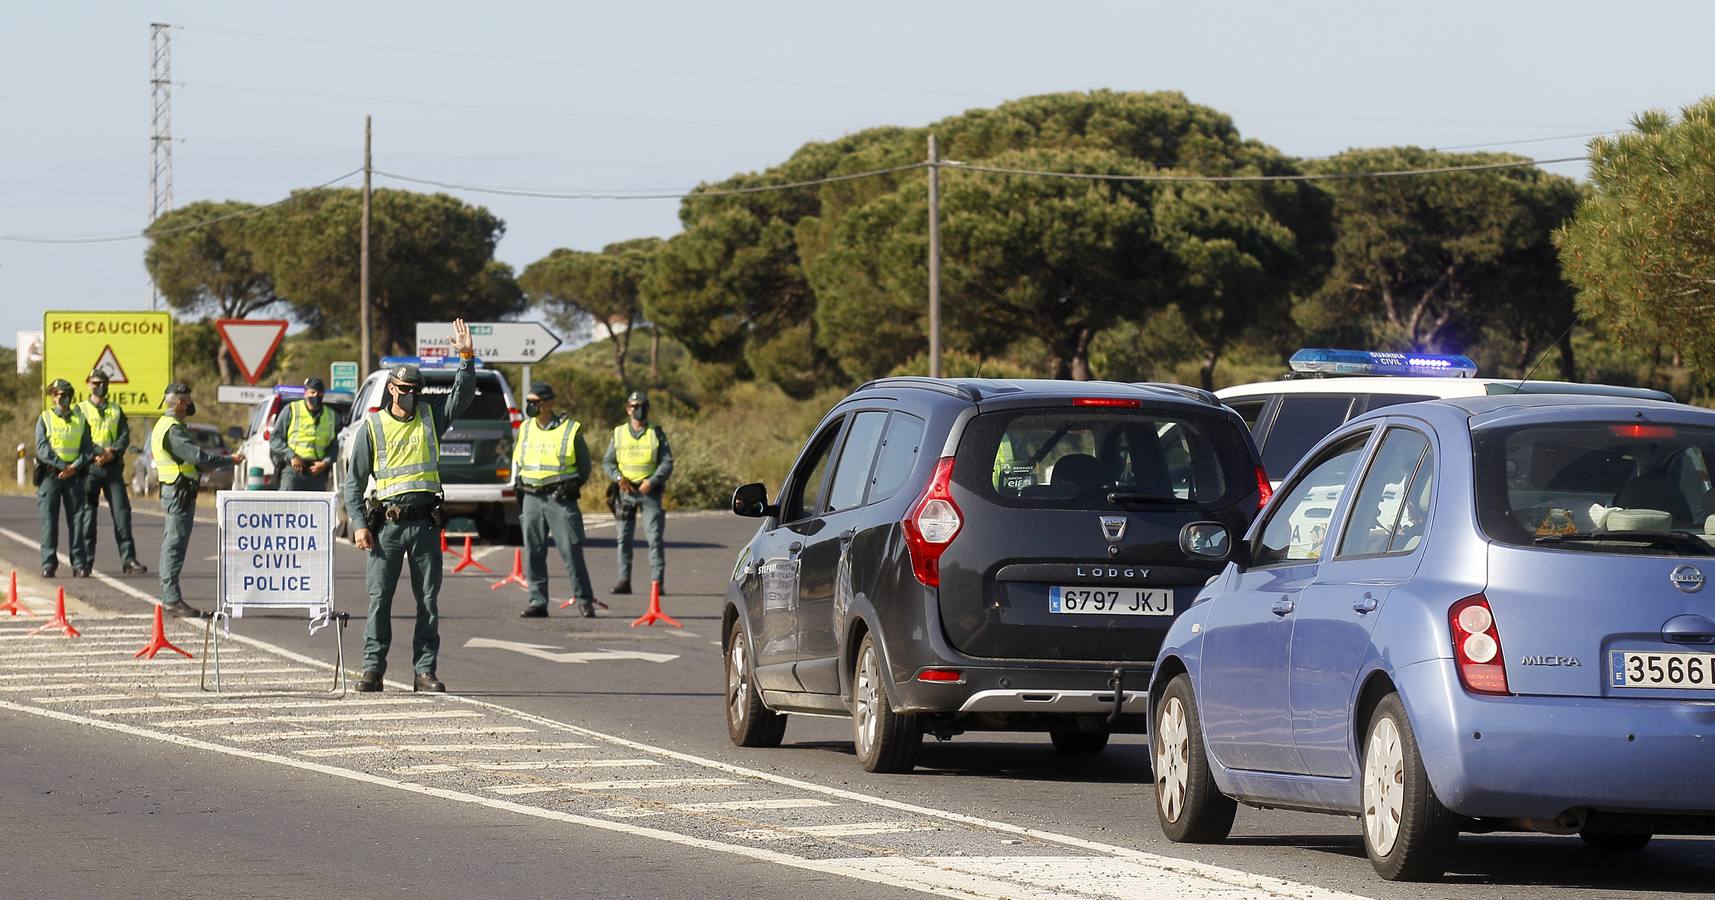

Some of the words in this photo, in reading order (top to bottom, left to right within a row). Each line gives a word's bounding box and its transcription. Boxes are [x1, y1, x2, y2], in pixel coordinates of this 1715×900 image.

[52, 319, 163, 334] PRECAUCIÓN
[1380, 358, 1402, 366] CIVIL
[237, 513, 318, 528] CONTROL
[237, 536, 317, 551] GUARDIA
[253, 554, 302, 569] CIVIL
[1077, 567, 1150, 578] LODGY
[243, 576, 311, 591] POLICE
[1065, 591, 1119, 611] 6797
[1128, 592, 1168, 612] JKJ
[1521, 655, 1582, 667] MICRA
[1616, 672, 1622, 680] E
[1629, 656, 1704, 684] 3566
